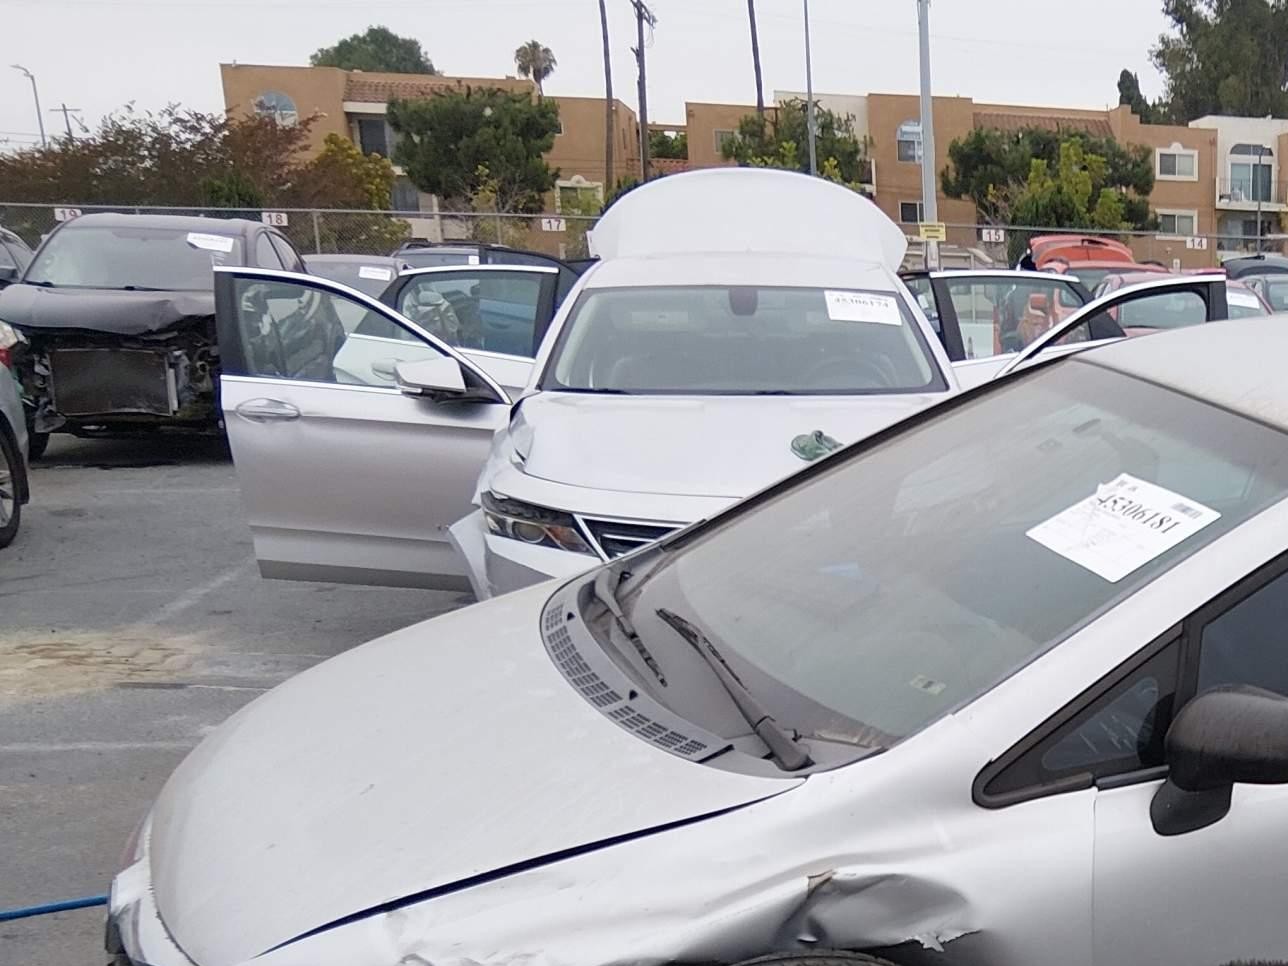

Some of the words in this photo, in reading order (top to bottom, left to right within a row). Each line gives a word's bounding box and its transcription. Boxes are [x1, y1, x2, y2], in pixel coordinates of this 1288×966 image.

[266, 214, 283, 225] 18
[546, 219, 562, 230] 17
[987, 229, 1001, 242] 15
[1191, 238, 1203, 249] 14
[1097, 494, 1180, 533] 45306181
